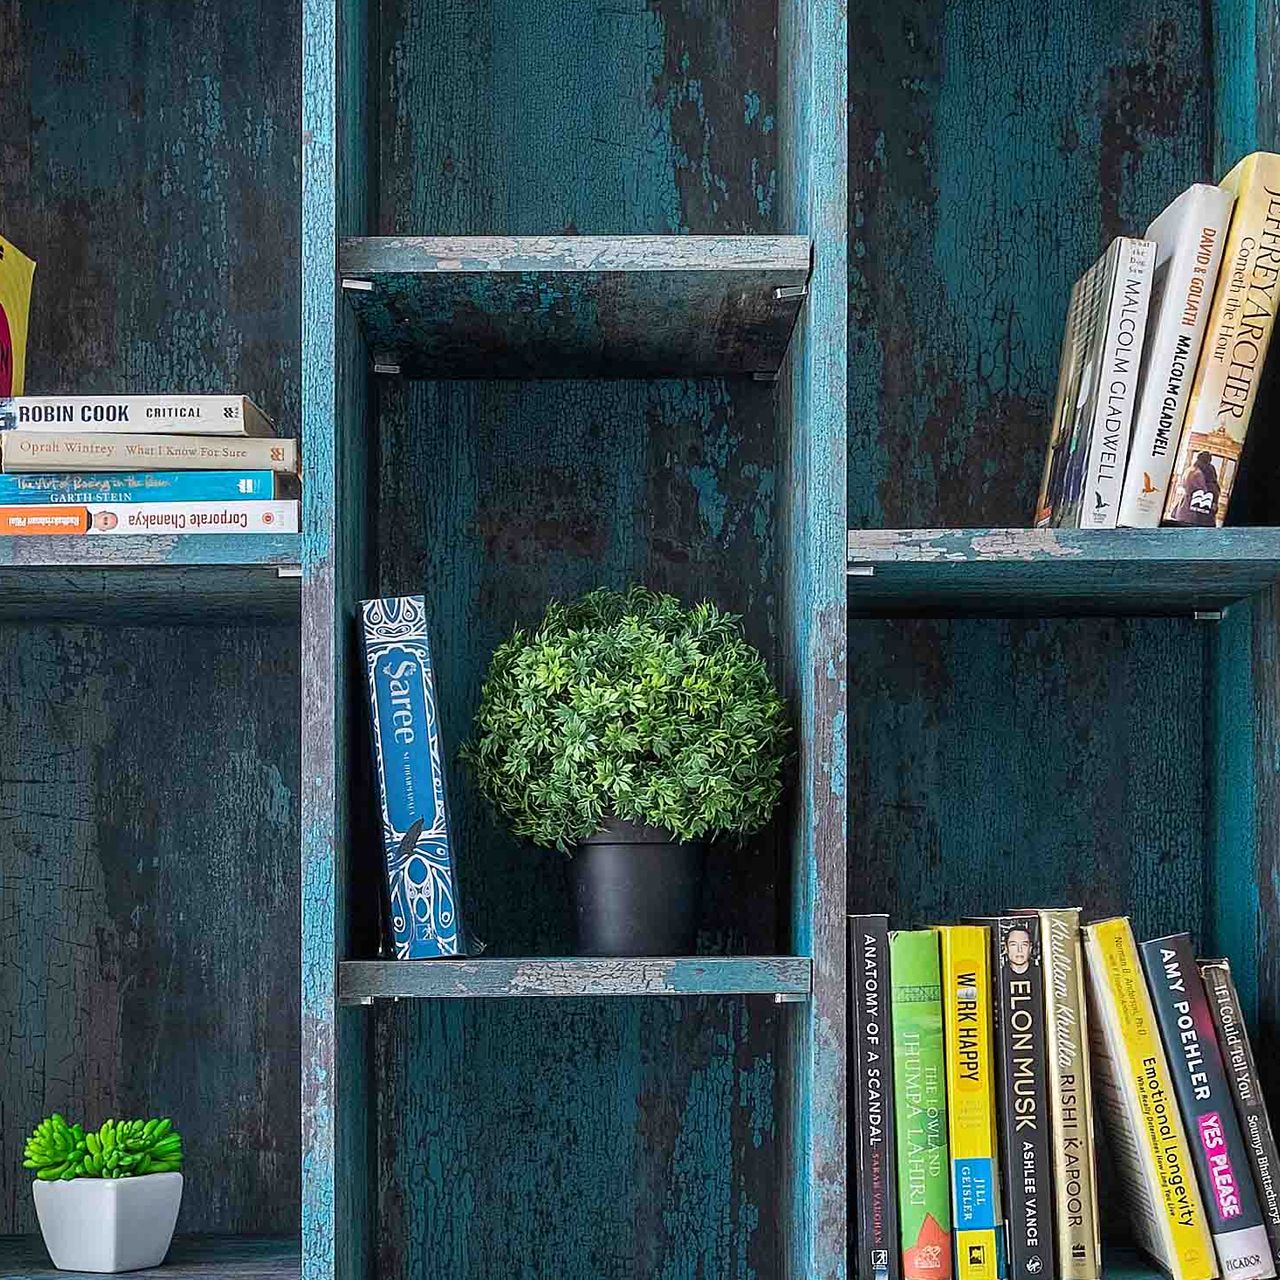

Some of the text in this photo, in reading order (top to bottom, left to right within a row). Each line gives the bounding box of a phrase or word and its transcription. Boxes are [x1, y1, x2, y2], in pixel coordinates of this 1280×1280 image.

[1182, 228, 1216, 326] DAVID GOLIATH
[1213, 236, 1256, 363] Cometh the Hour
[19, 405, 130, 422] ROBIN COOK
[146, 407, 201, 418] CRITICAL
[1098, 279, 1141, 483] MALCOLM GLADWELL
[1152, 335, 1192, 457] MALCOLM GLADWELL
[1218, 299, 1271, 419] ARCHER
[20, 442, 115, 457] Oprah Winfrey
[128, 512, 248, 527] Corporate Chanakya
[383, 661, 416, 745] Saree
[862, 933, 881, 1146] ANATOMY OF SCANDAL
[955, 1027, 980, 1082] HAPPY
[1009, 980, 1037, 1130] ELON MUSK
[1159, 948, 1239, 1216] AMY POEHLER YES PLEASE
[1221, 1005, 1240, 1044] Could
[902, 1032, 927, 1207] JHUMPA LAHIRI
[1059, 1074, 1083, 1227] RISHI KAPOOR
[1143, 1057, 1194, 1227] Emotional Longevity
[1022, 1141, 1039, 1246] ASHLEE VANCE
